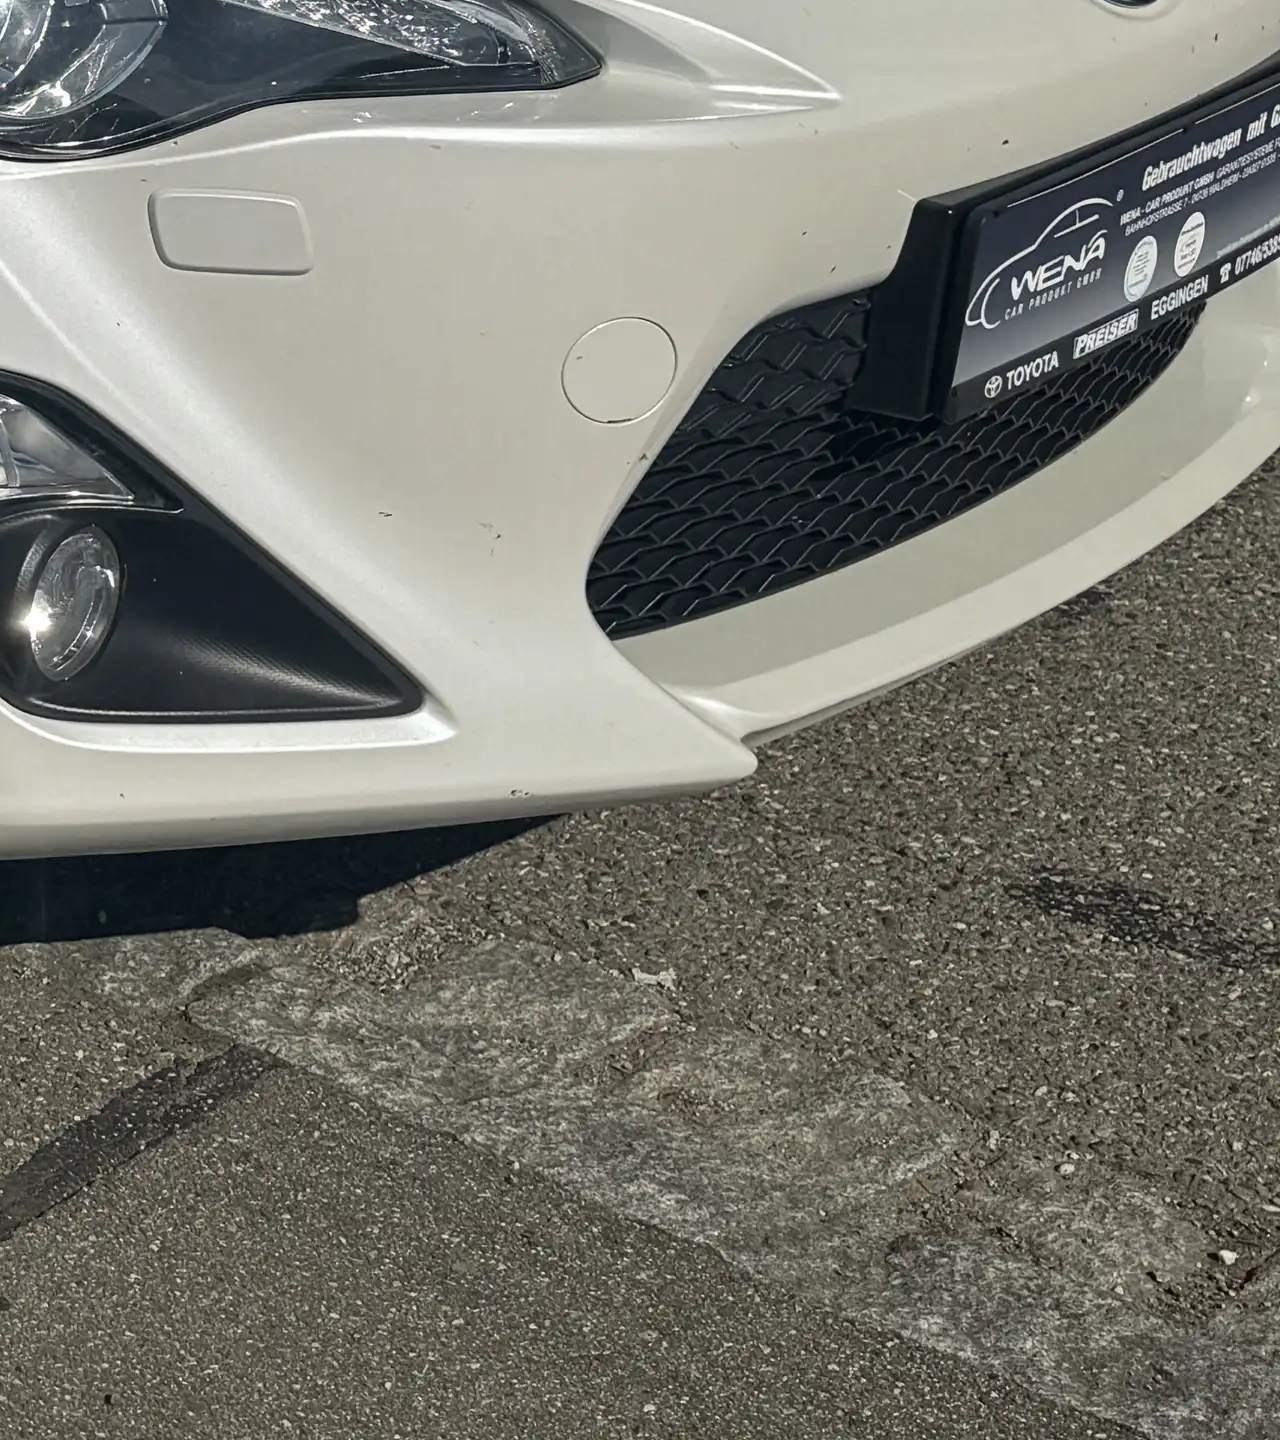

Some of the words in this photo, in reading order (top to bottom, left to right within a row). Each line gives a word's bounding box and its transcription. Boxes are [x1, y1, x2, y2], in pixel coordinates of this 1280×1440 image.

[1142, 128, 1242, 191] Gebrauchtwagen
[1246, 111, 1268, 142] mit
[1004, 303, 1024, 320] CAR
[1028, 281, 1072, 310] PRODUKT
[1011, 231, 1108, 300] WENA
[1006, 351, 1059, 390] TOYOTA
[1074, 312, 1137, 358] PREISER
[1151, 274, 1209, 320] EGGINGEN
